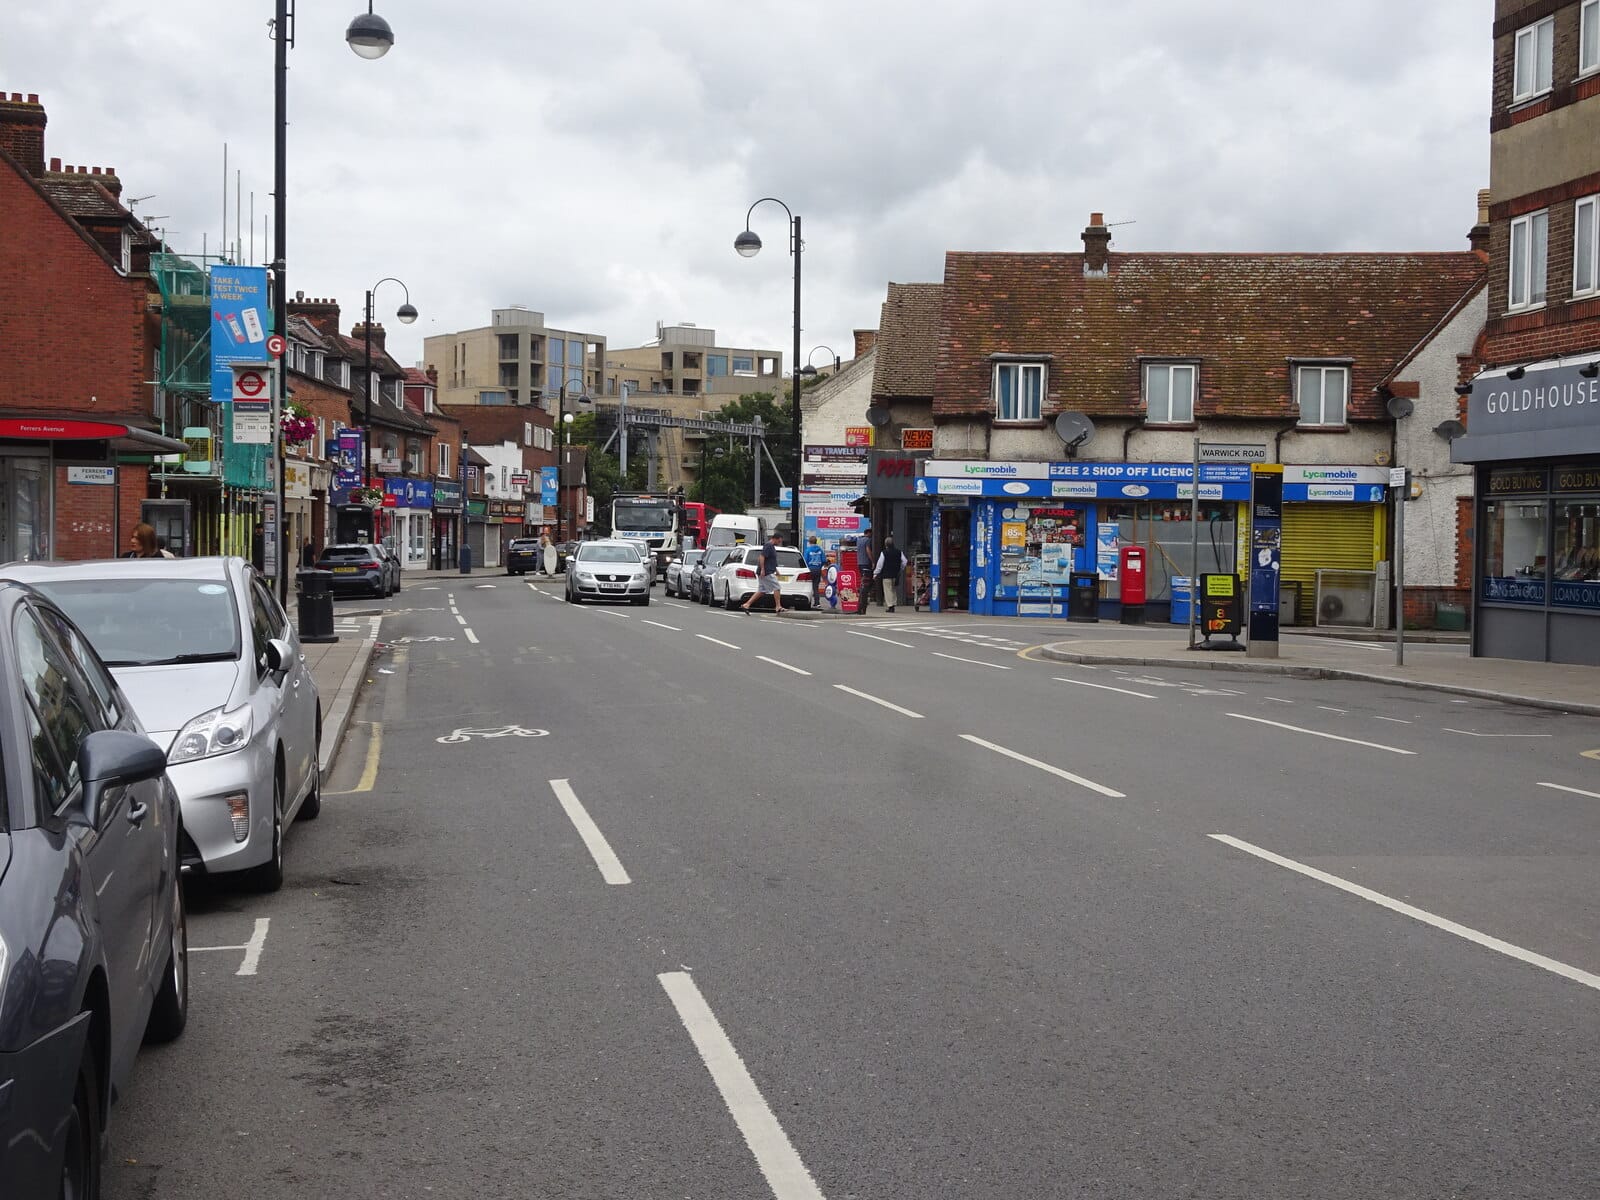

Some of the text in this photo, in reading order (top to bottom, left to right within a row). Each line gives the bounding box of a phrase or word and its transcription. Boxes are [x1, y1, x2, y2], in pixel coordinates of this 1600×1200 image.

[213, 277, 233, 285] TAKE
[269, 338, 281, 354] G
[1487, 380, 1598, 414] GOLDHOUSE
[904, 430, 932, 440] NEWS
[904, 440, 931, 448] AGENT
[1202, 449, 1265, 458] WARWICK ROAD
[965, 464, 1017, 475] Lycamobile
[1050, 466, 1079, 476] EZEE
[1082, 466, 1090, 476] 2
[1093, 467, 1123, 476] SHOP
[1126, 467, 1148, 476] OFF
[1303, 469, 1358, 480] Lycamobile
[1490, 475, 1542, 490] GOLD BUYING
[1560, 474, 1584, 487] GOLD
[939, 482, 980, 492] Lycamobile
[1053, 484, 1095, 494] Lycamobile
[1309, 487, 1353, 497] Lycamobile
[1048, 509, 1076, 517] LICENCE
[829, 517, 847, 525] £35
[1485, 583, 1544, 600] LOANS ON GOLD
[1554, 587, 1595, 603] LOANS ON
